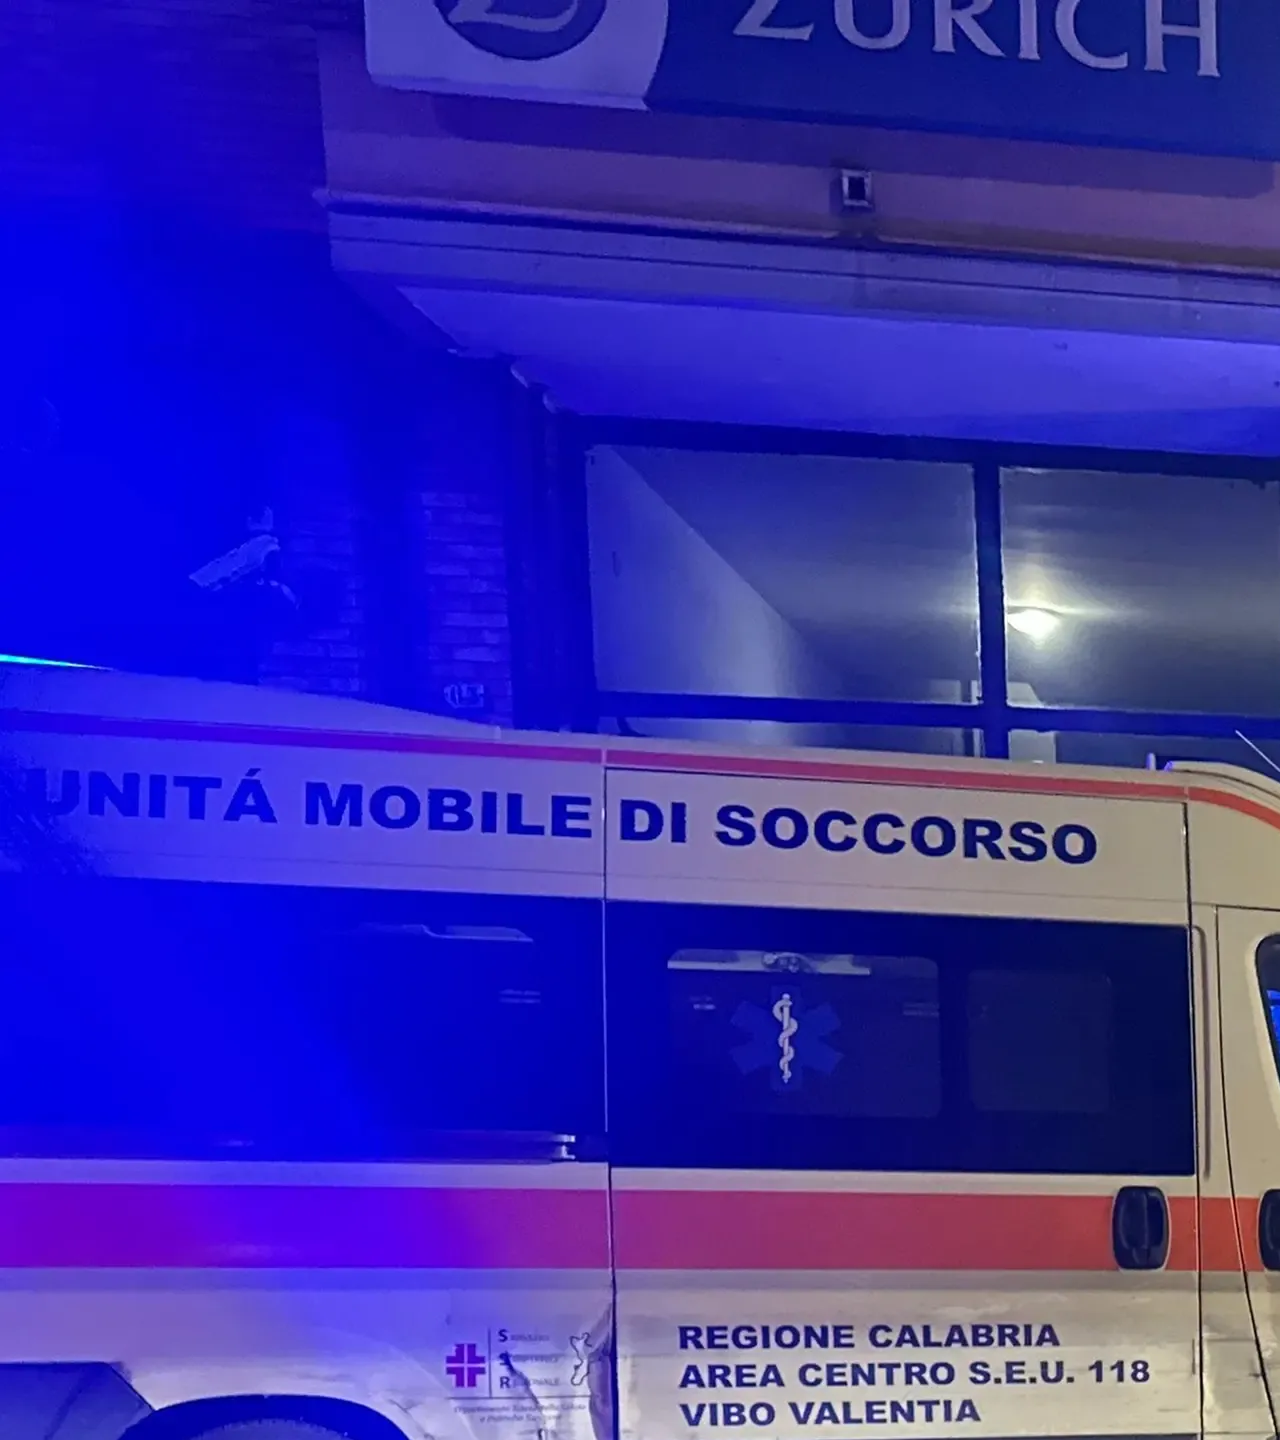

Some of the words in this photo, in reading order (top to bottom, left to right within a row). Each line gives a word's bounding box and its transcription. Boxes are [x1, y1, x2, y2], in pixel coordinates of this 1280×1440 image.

[305, 781, 593, 838] MOBILE
[620, 798, 687, 844] DI
[715, 804, 1097, 865] SOCCORSO
[678, 1324, 855, 1350] REGIONE
[868, 1323, 1061, 1348] CALABRIA
[679, 1363, 785, 1389] AREA
[798, 1361, 956, 1387] CENTRO
[968, 1360, 1075, 1385] S.E.U.
[1088, 1360, 1151, 1384] 118
[679, 1402, 777, 1428] VIBO
[787, 1399, 982, 1425] VALENTIA
